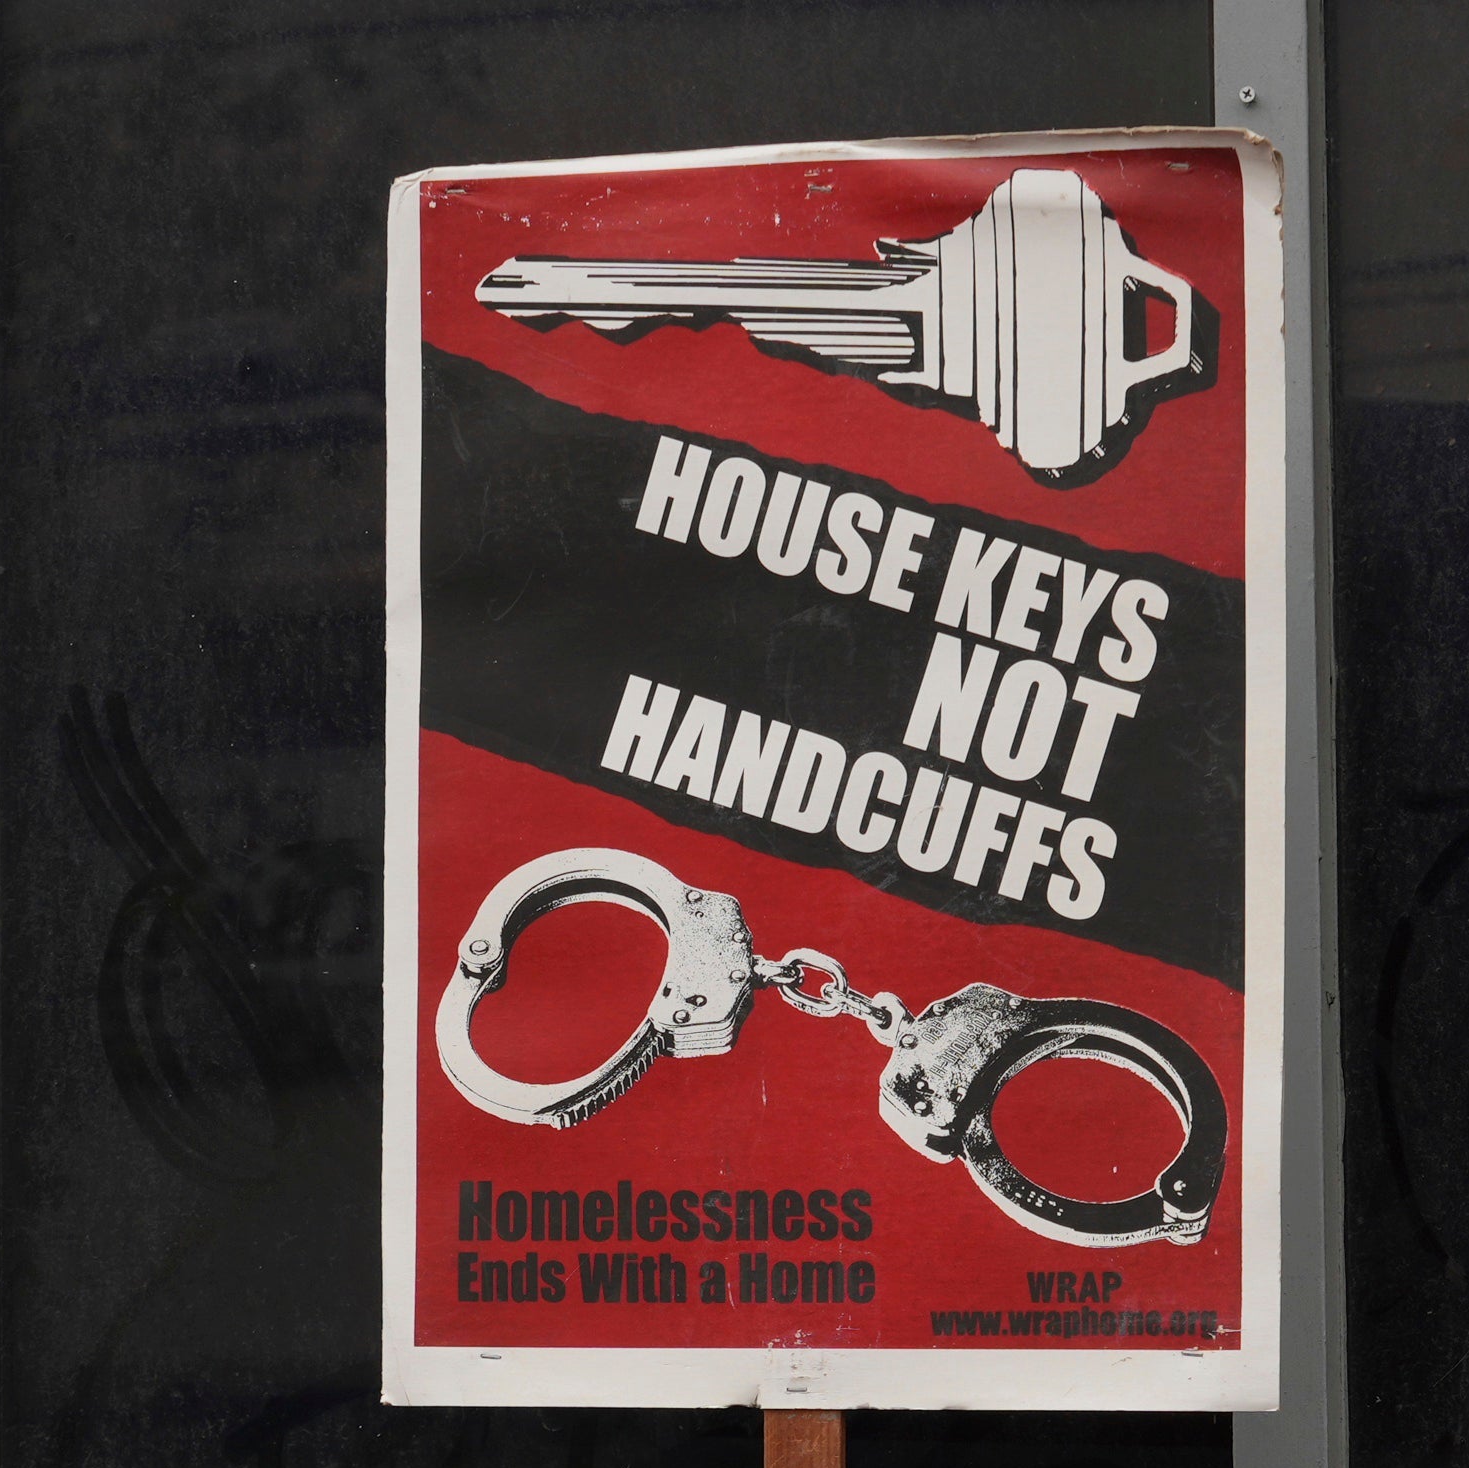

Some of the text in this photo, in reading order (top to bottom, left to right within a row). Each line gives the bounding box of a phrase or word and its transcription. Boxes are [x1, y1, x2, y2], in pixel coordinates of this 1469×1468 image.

[636, 435, 1170, 682] HOUSE KEYS
[902, 631, 1142, 802] NOT
[600, 674, 1118, 920] HANDCUFFS
[458, 1180, 873, 1243] Homelessness
[457, 1251, 876, 1305] Ends With a Home
[1026, 1271, 1123, 1303] WRAP
[930, 1306, 1219, 1340] www.wraphome.org
